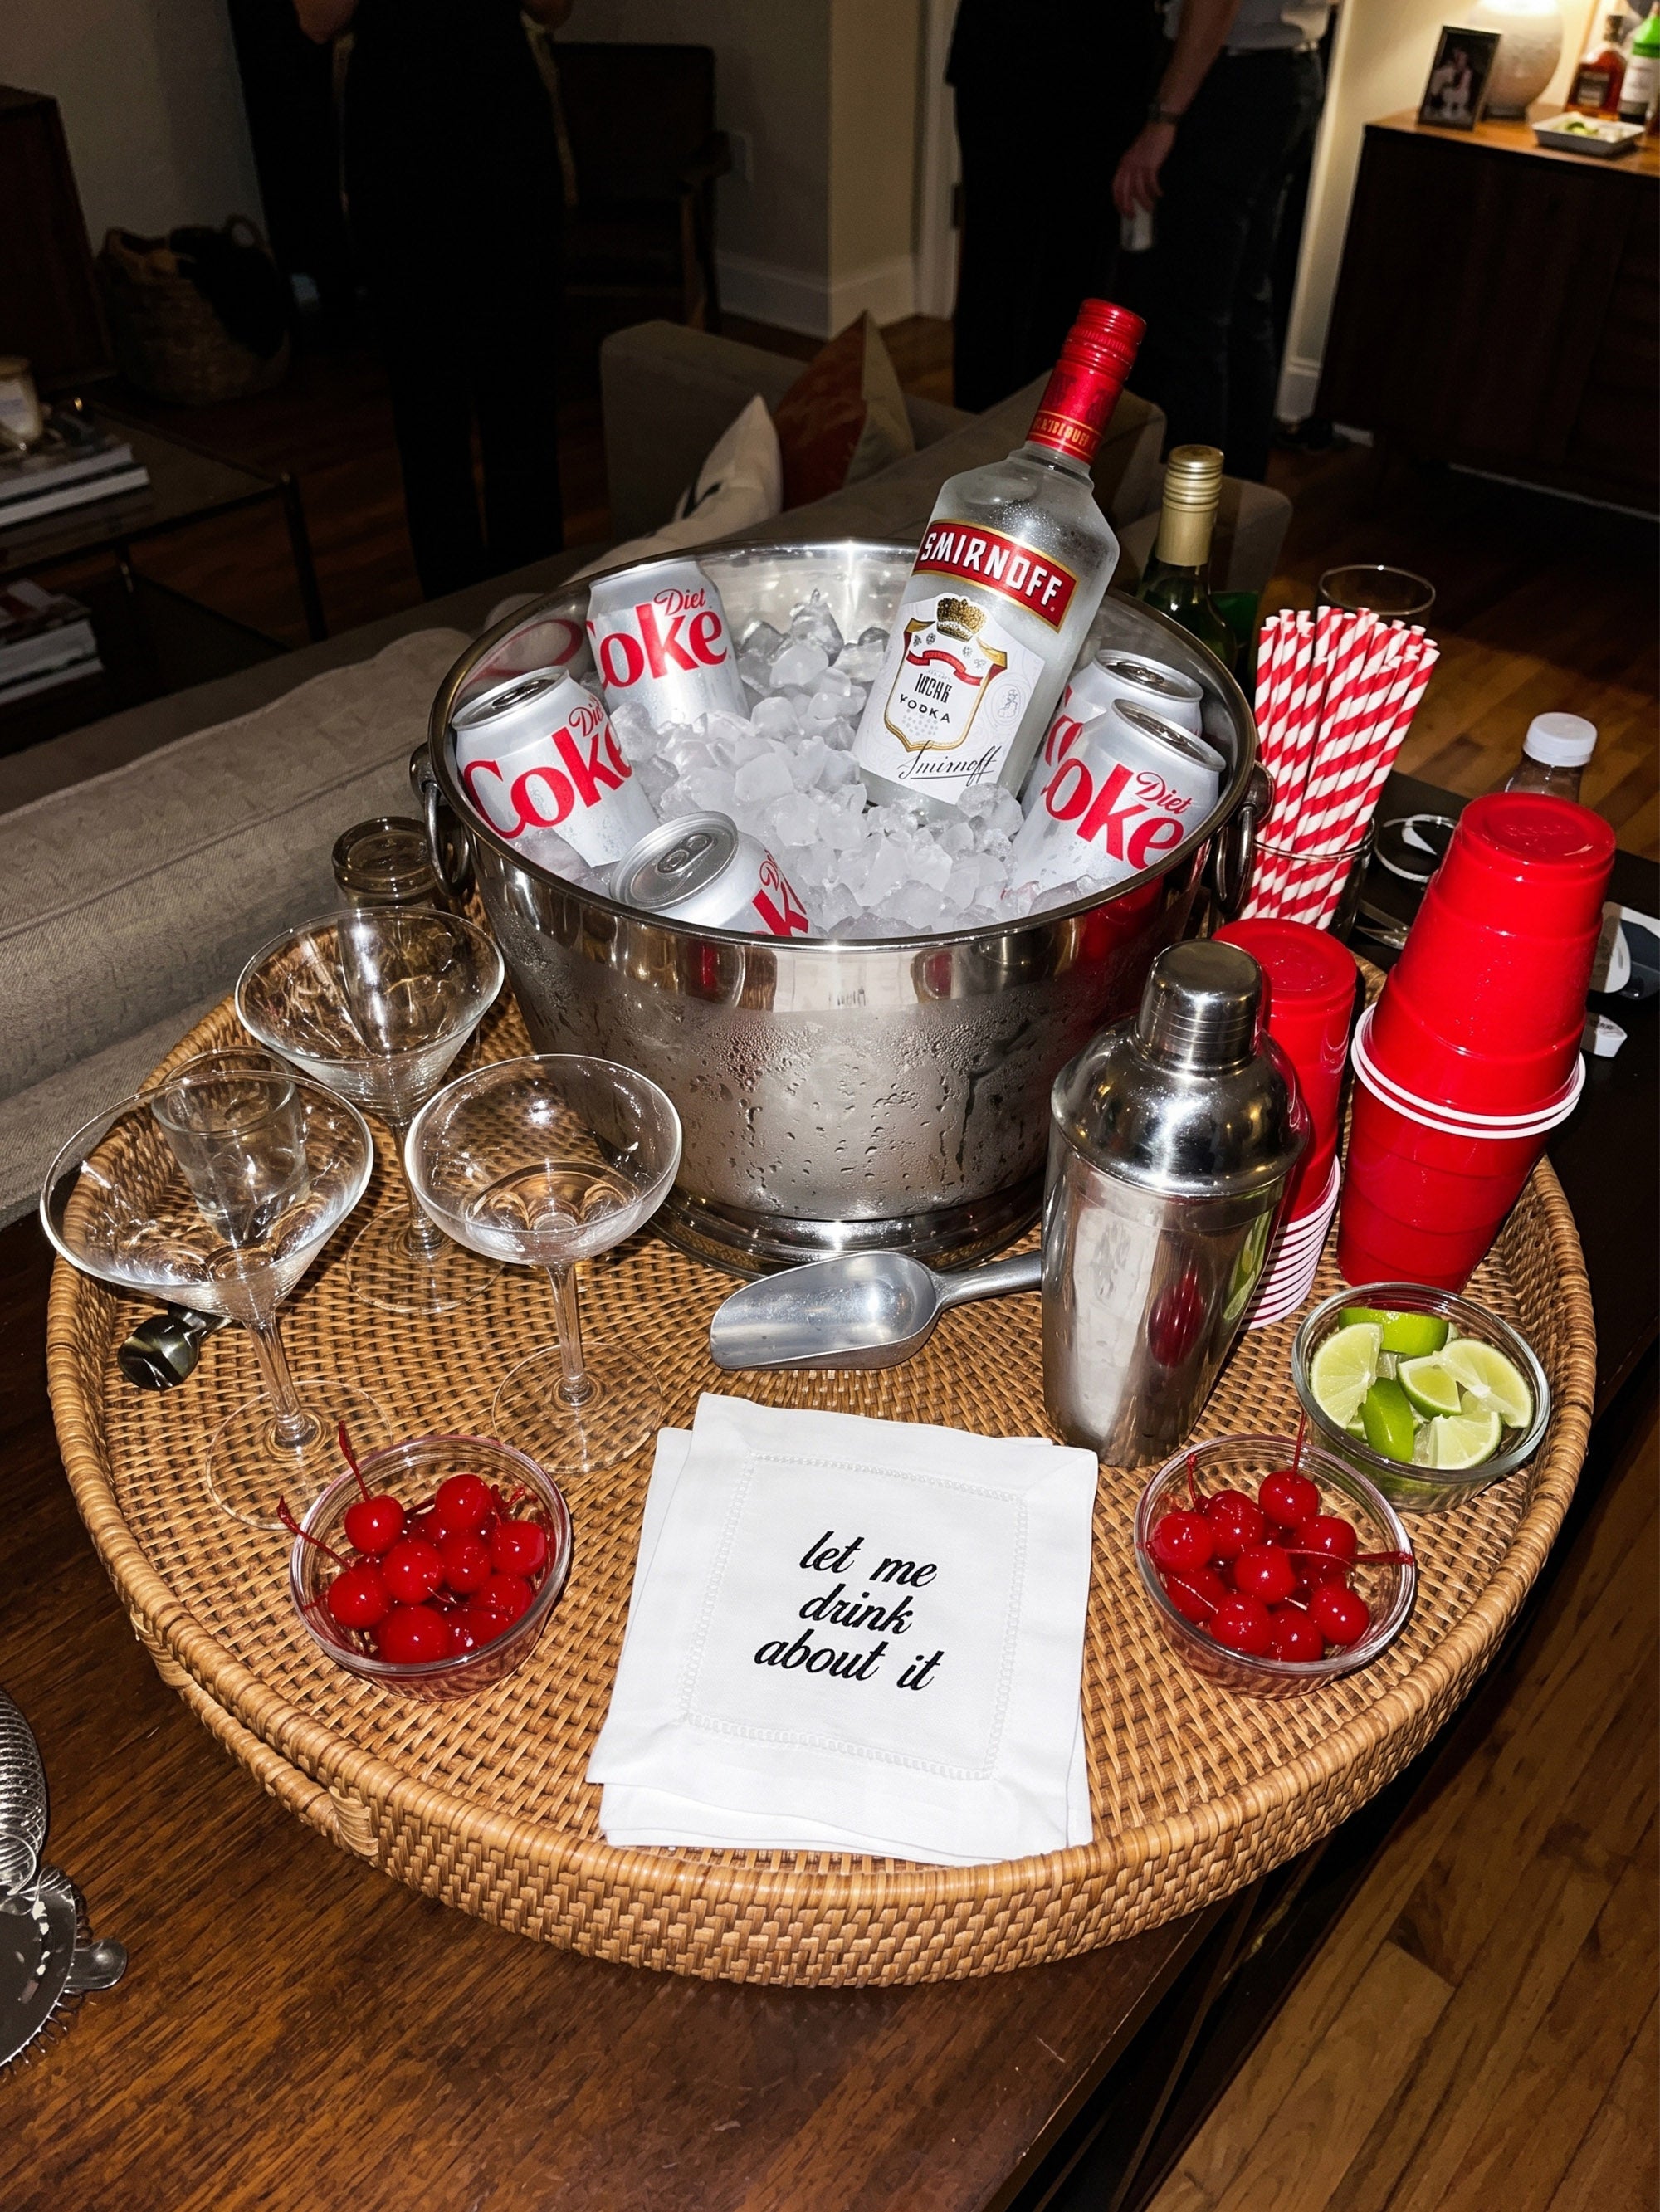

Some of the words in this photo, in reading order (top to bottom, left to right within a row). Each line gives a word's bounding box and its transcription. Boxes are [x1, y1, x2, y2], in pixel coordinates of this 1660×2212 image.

[920, 531, 1062, 606] SMIRNOFF
[653, 588, 706, 616] Diet
[900, 694, 950, 724] VODKA
[896, 740, 1003, 787] Smirnoff
[1040, 757, 1184, 871] oke
[1135, 771, 1193, 815] Diet
[798, 1530, 865, 1574] let
[868, 1556, 938, 1588] me
[798, 1582, 914, 1635] drink
[754, 1628, 890, 1682] about
[896, 1649, 945, 1692] it
